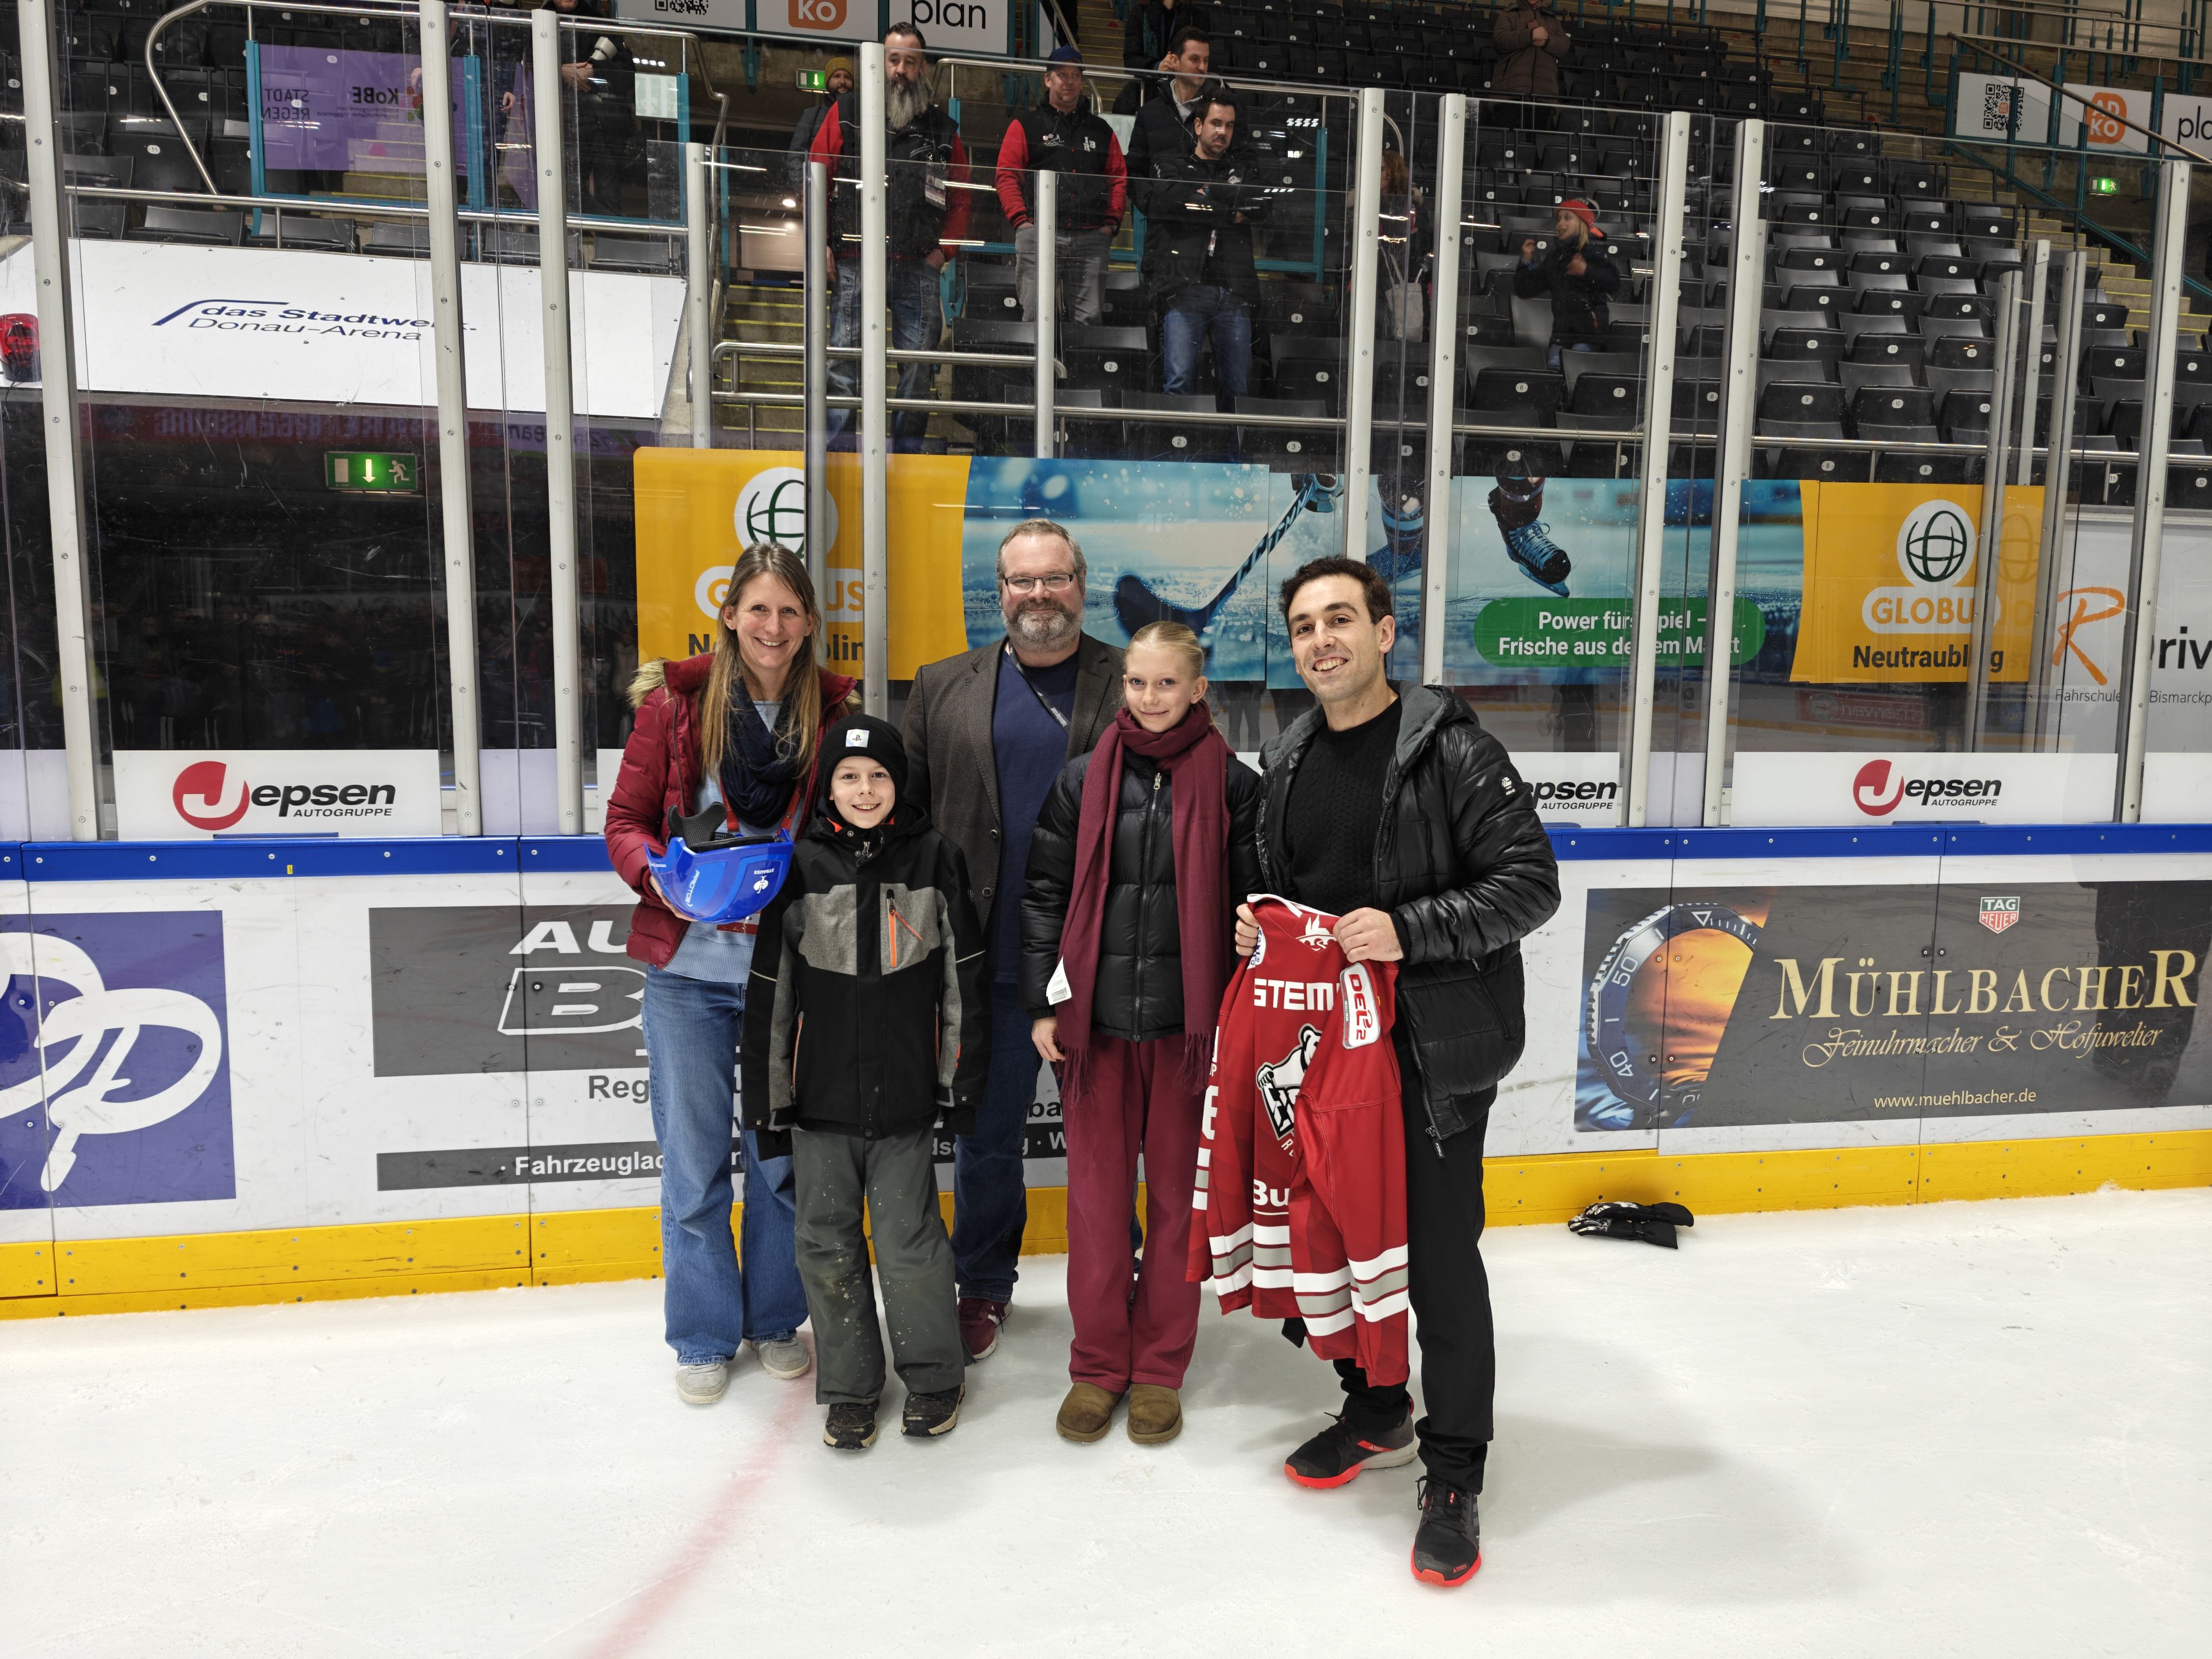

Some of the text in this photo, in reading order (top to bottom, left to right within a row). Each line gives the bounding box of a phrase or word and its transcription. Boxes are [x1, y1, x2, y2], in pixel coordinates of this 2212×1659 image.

[912, 0, 987, 29] plan
[2093, 99, 2120, 115] AD
[2089, 118, 2119, 137] KO
[201, 306, 268, 318] das
[188, 318, 422, 341] Donau-Arena
[1539, 611, 1597, 630] Power
[1657, 610, 1691, 633] piel
[1871, 597, 1974, 624] GLOBU
[1499, 637, 1568, 655] Frische
[1574, 641, 1606, 655] aus
[1612, 637, 1680, 655] deem
[2150, 626, 2212, 669] riv
[1853, 644, 2004, 673] Neutraublg
[2055, 689, 2121, 702] Fahrschule
[293, 808, 393, 818] AUTOGRUPPE
[685, 869, 700, 903] PROTOS
[1983, 898, 2018, 911] TAG
[1981, 913, 2018, 930] HEUER
[1611, 955, 1638, 987] 50
[1253, 977, 1339, 1011] STEM
[1769, 949, 2198, 1020] MÜHLBACHER
[1802, 1020, 2163, 1068] Feinuhrmacher & Hofjuwelier
[1609, 1051, 1634, 1077] 40
[1873, 1088, 2037, 1109] www.muehlbacher.de
